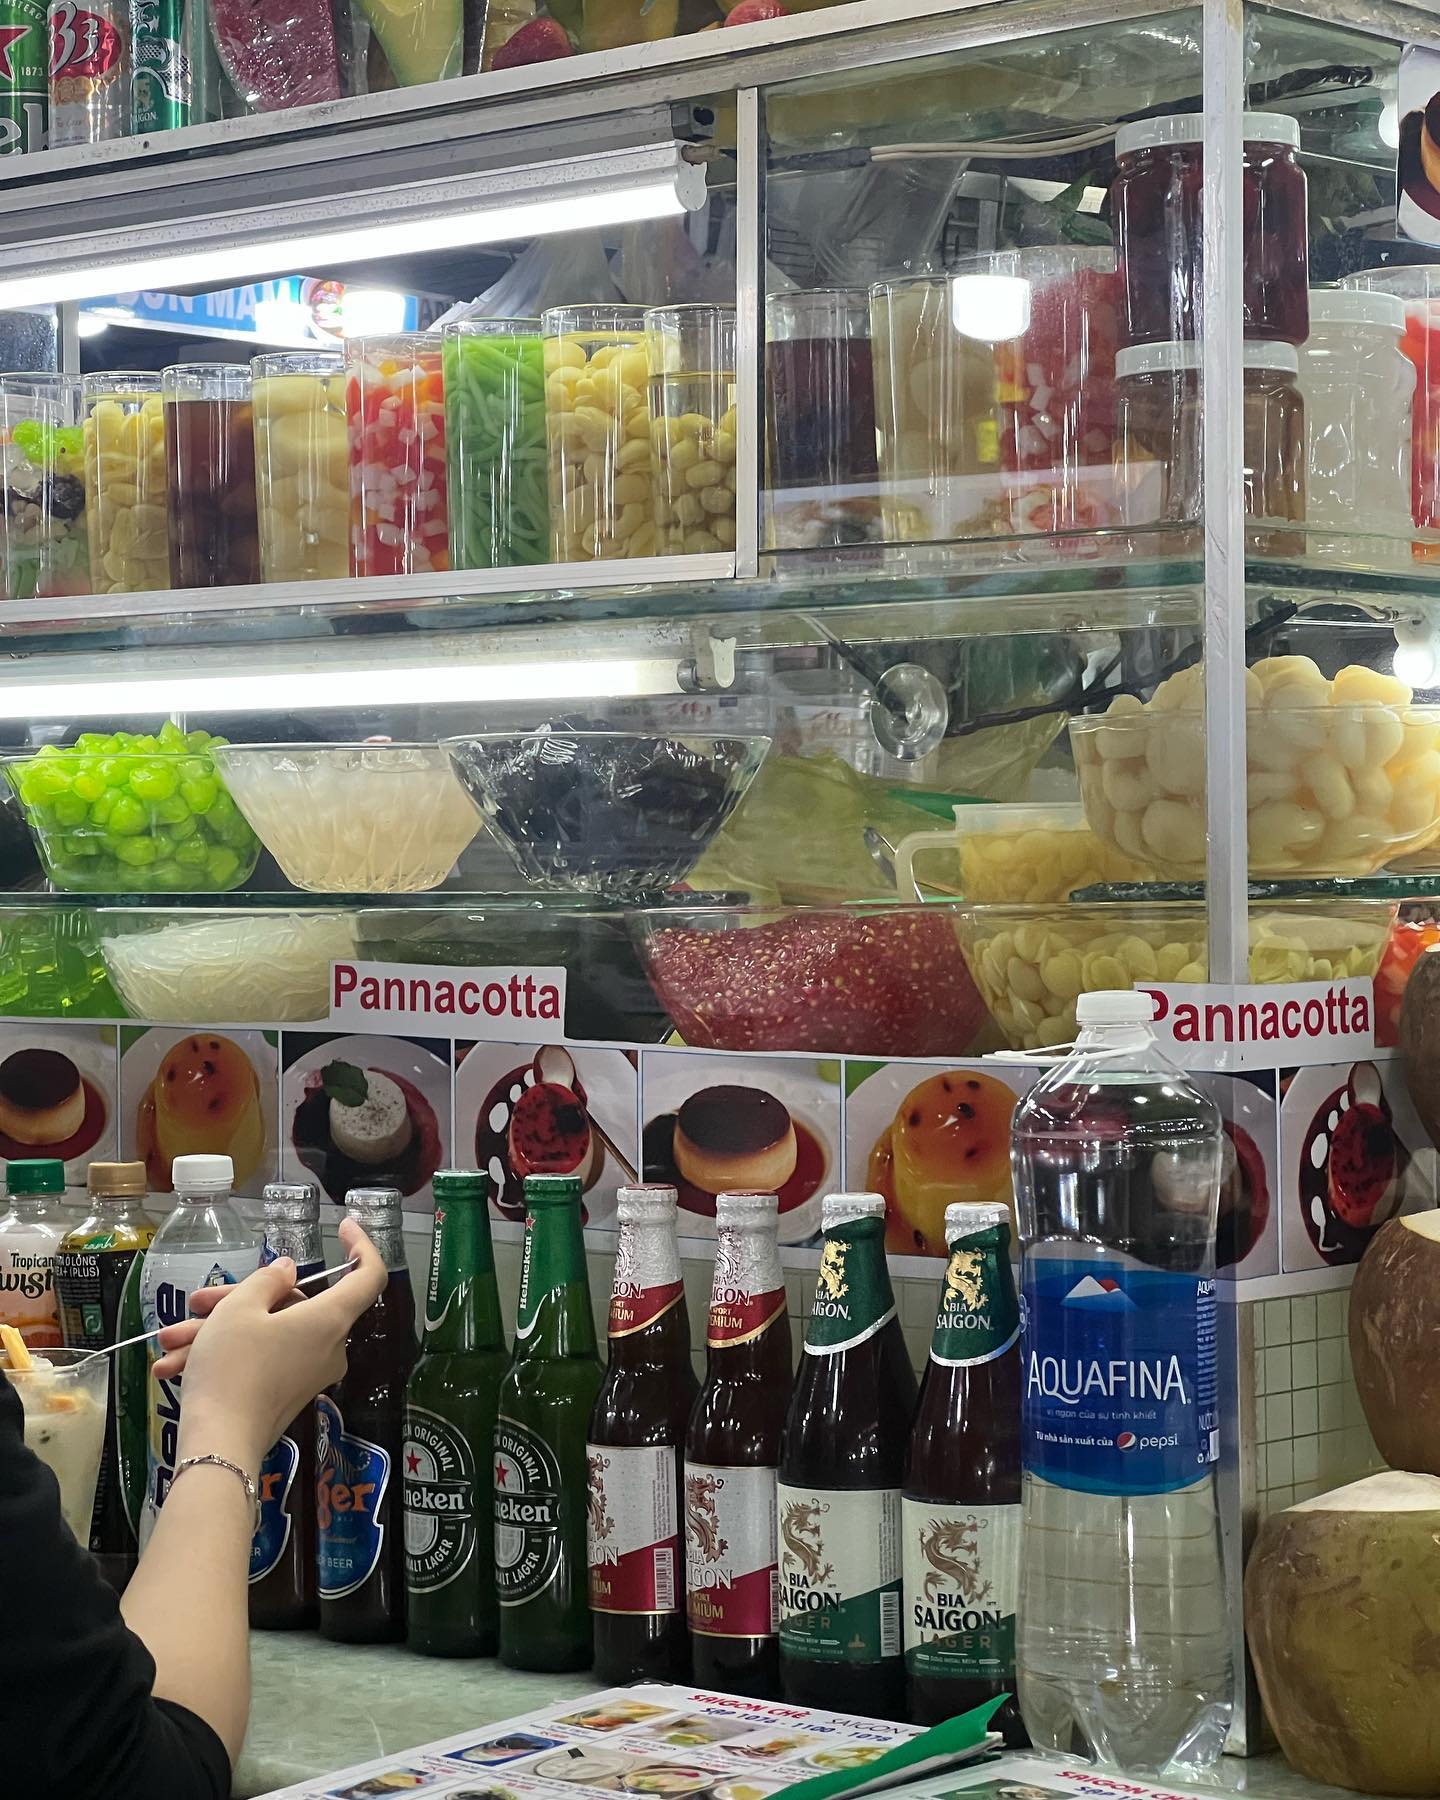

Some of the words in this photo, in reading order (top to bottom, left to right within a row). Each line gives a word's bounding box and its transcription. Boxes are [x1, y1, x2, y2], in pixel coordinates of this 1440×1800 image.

[21, 66, 44, 77] 1873
[334, 964, 561, 1019] Pannacotta
[11, 1253, 55, 1270] Tropican
[430, 1229, 442, 1302] Heineken
[520, 1236, 532, 1309] Heineken
[950, 1302, 968, 1313] BIA
[936, 1314, 991, 1331] SAIGON
[1027, 1350, 1187, 1405] AQUAFINA
[414, 1425, 455, 1472] ORIGINAL
[1139, 1433, 1179, 1450] pepsi
[502, 1436, 541, 1483] ORIGINAL
[327, 1557, 353, 1569] BEER
[426, 1538, 454, 1571] LAGER
[512, 1551, 541, 1585] LAGER
[789, 1572, 810, 1589] BIA
[937, 1592, 966, 1608] BIA
[914, 1604, 1002, 1632] SAIGON
[688, 1693, 768, 1712] SAIGON
[826, 1717, 908, 1735] SAIGON
[1055, 1770, 1149, 1795] SAIGON
